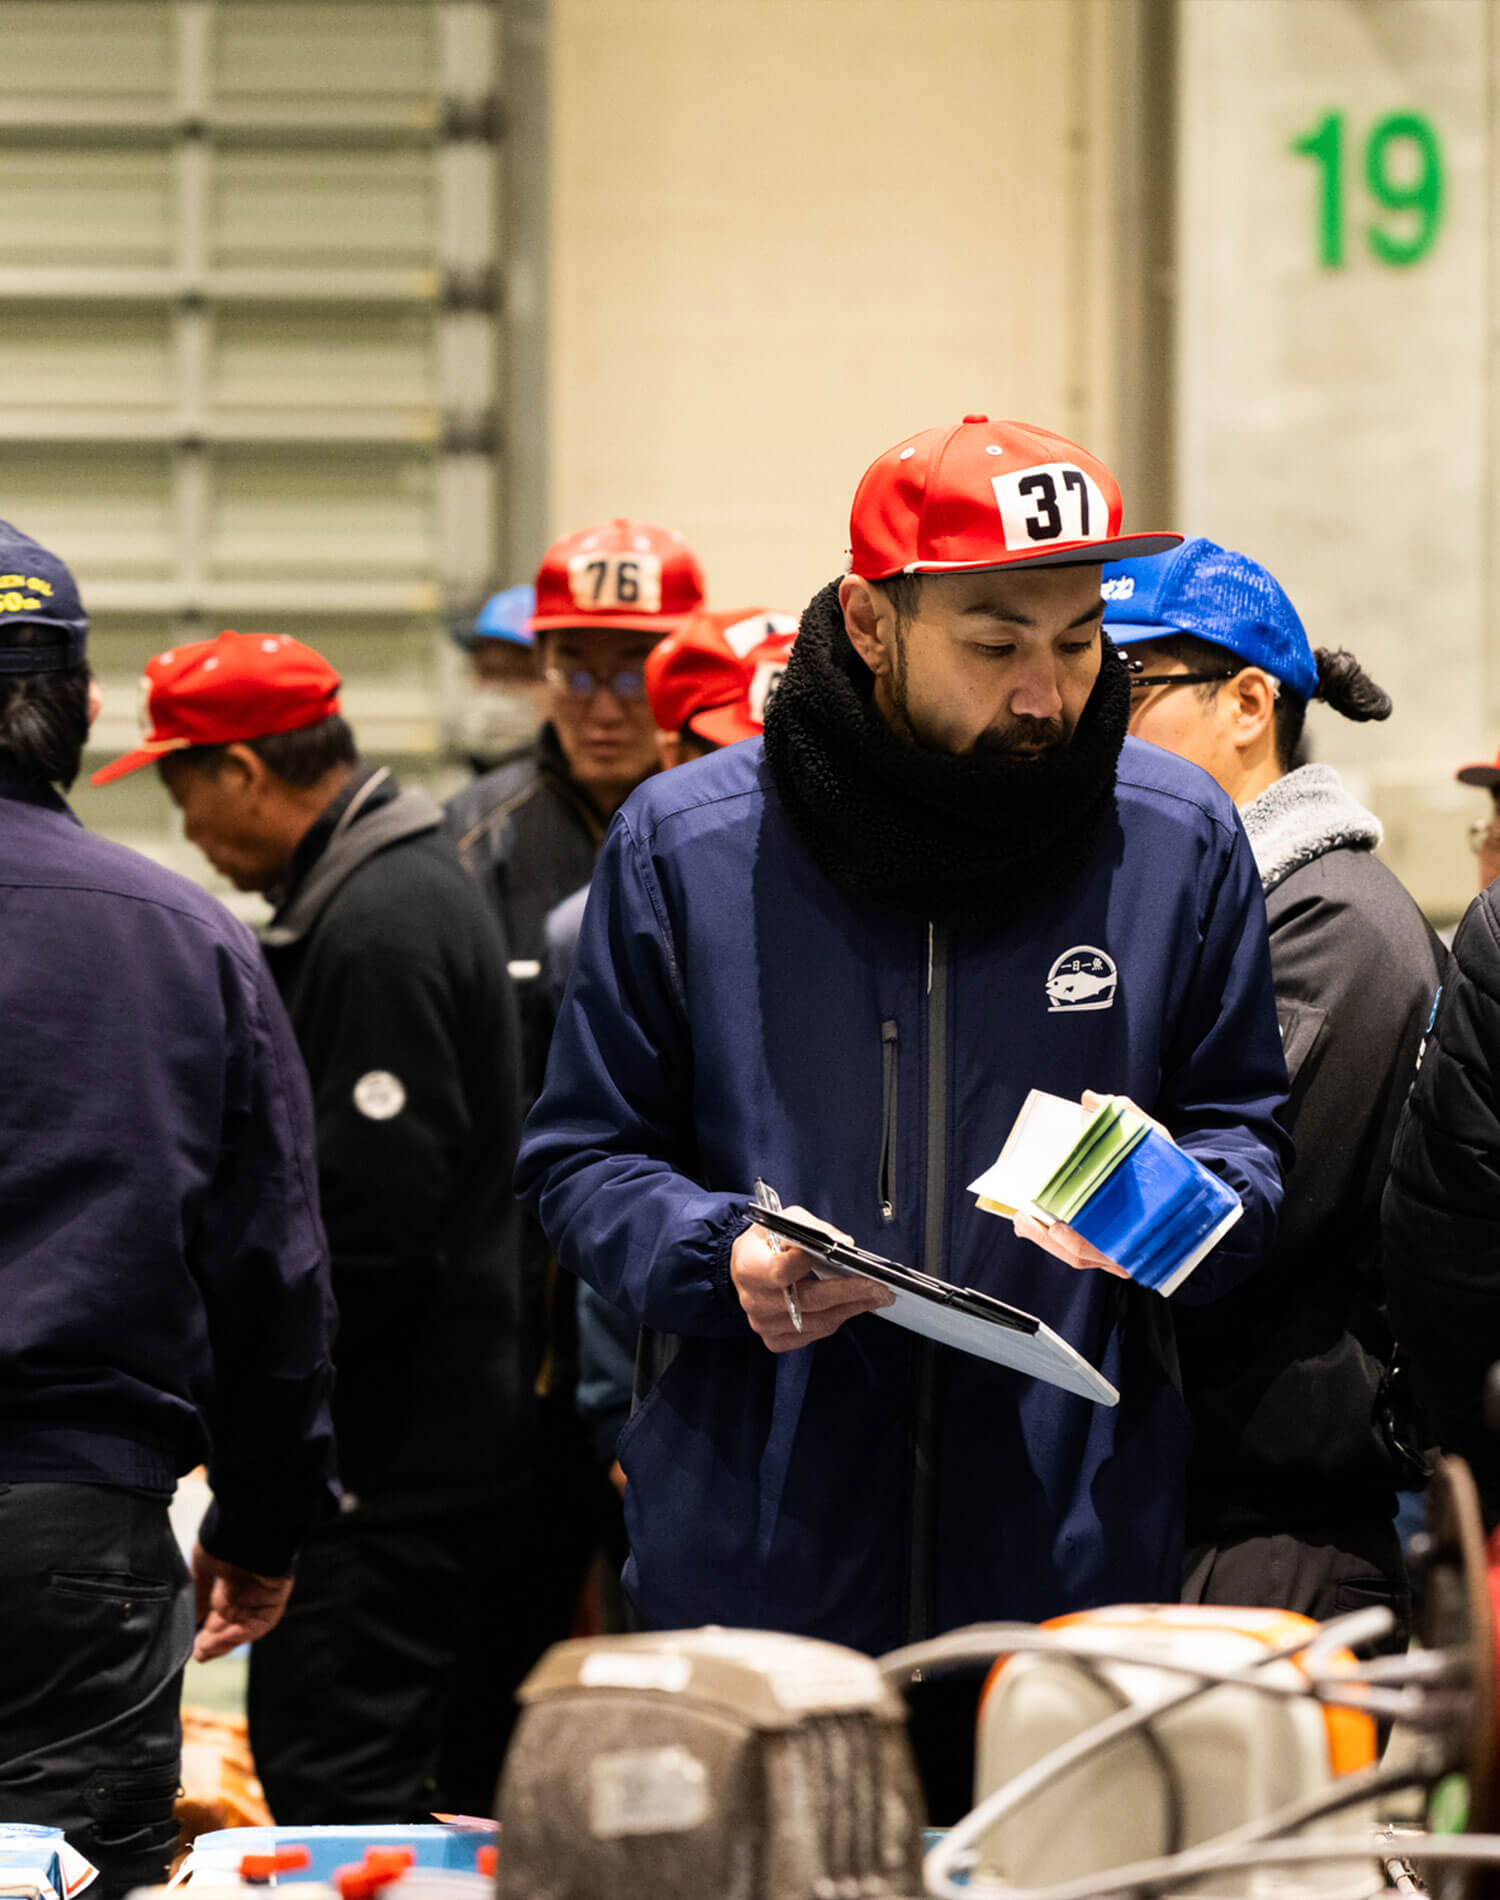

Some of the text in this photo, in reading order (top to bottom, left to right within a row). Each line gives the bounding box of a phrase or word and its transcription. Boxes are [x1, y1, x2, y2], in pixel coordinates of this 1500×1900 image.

[1290, 107, 1444, 270] 19
[1018, 470, 1090, 541] 37
[585, 561, 640, 604] 76
[1060, 957, 1104, 972] 一日一魚
